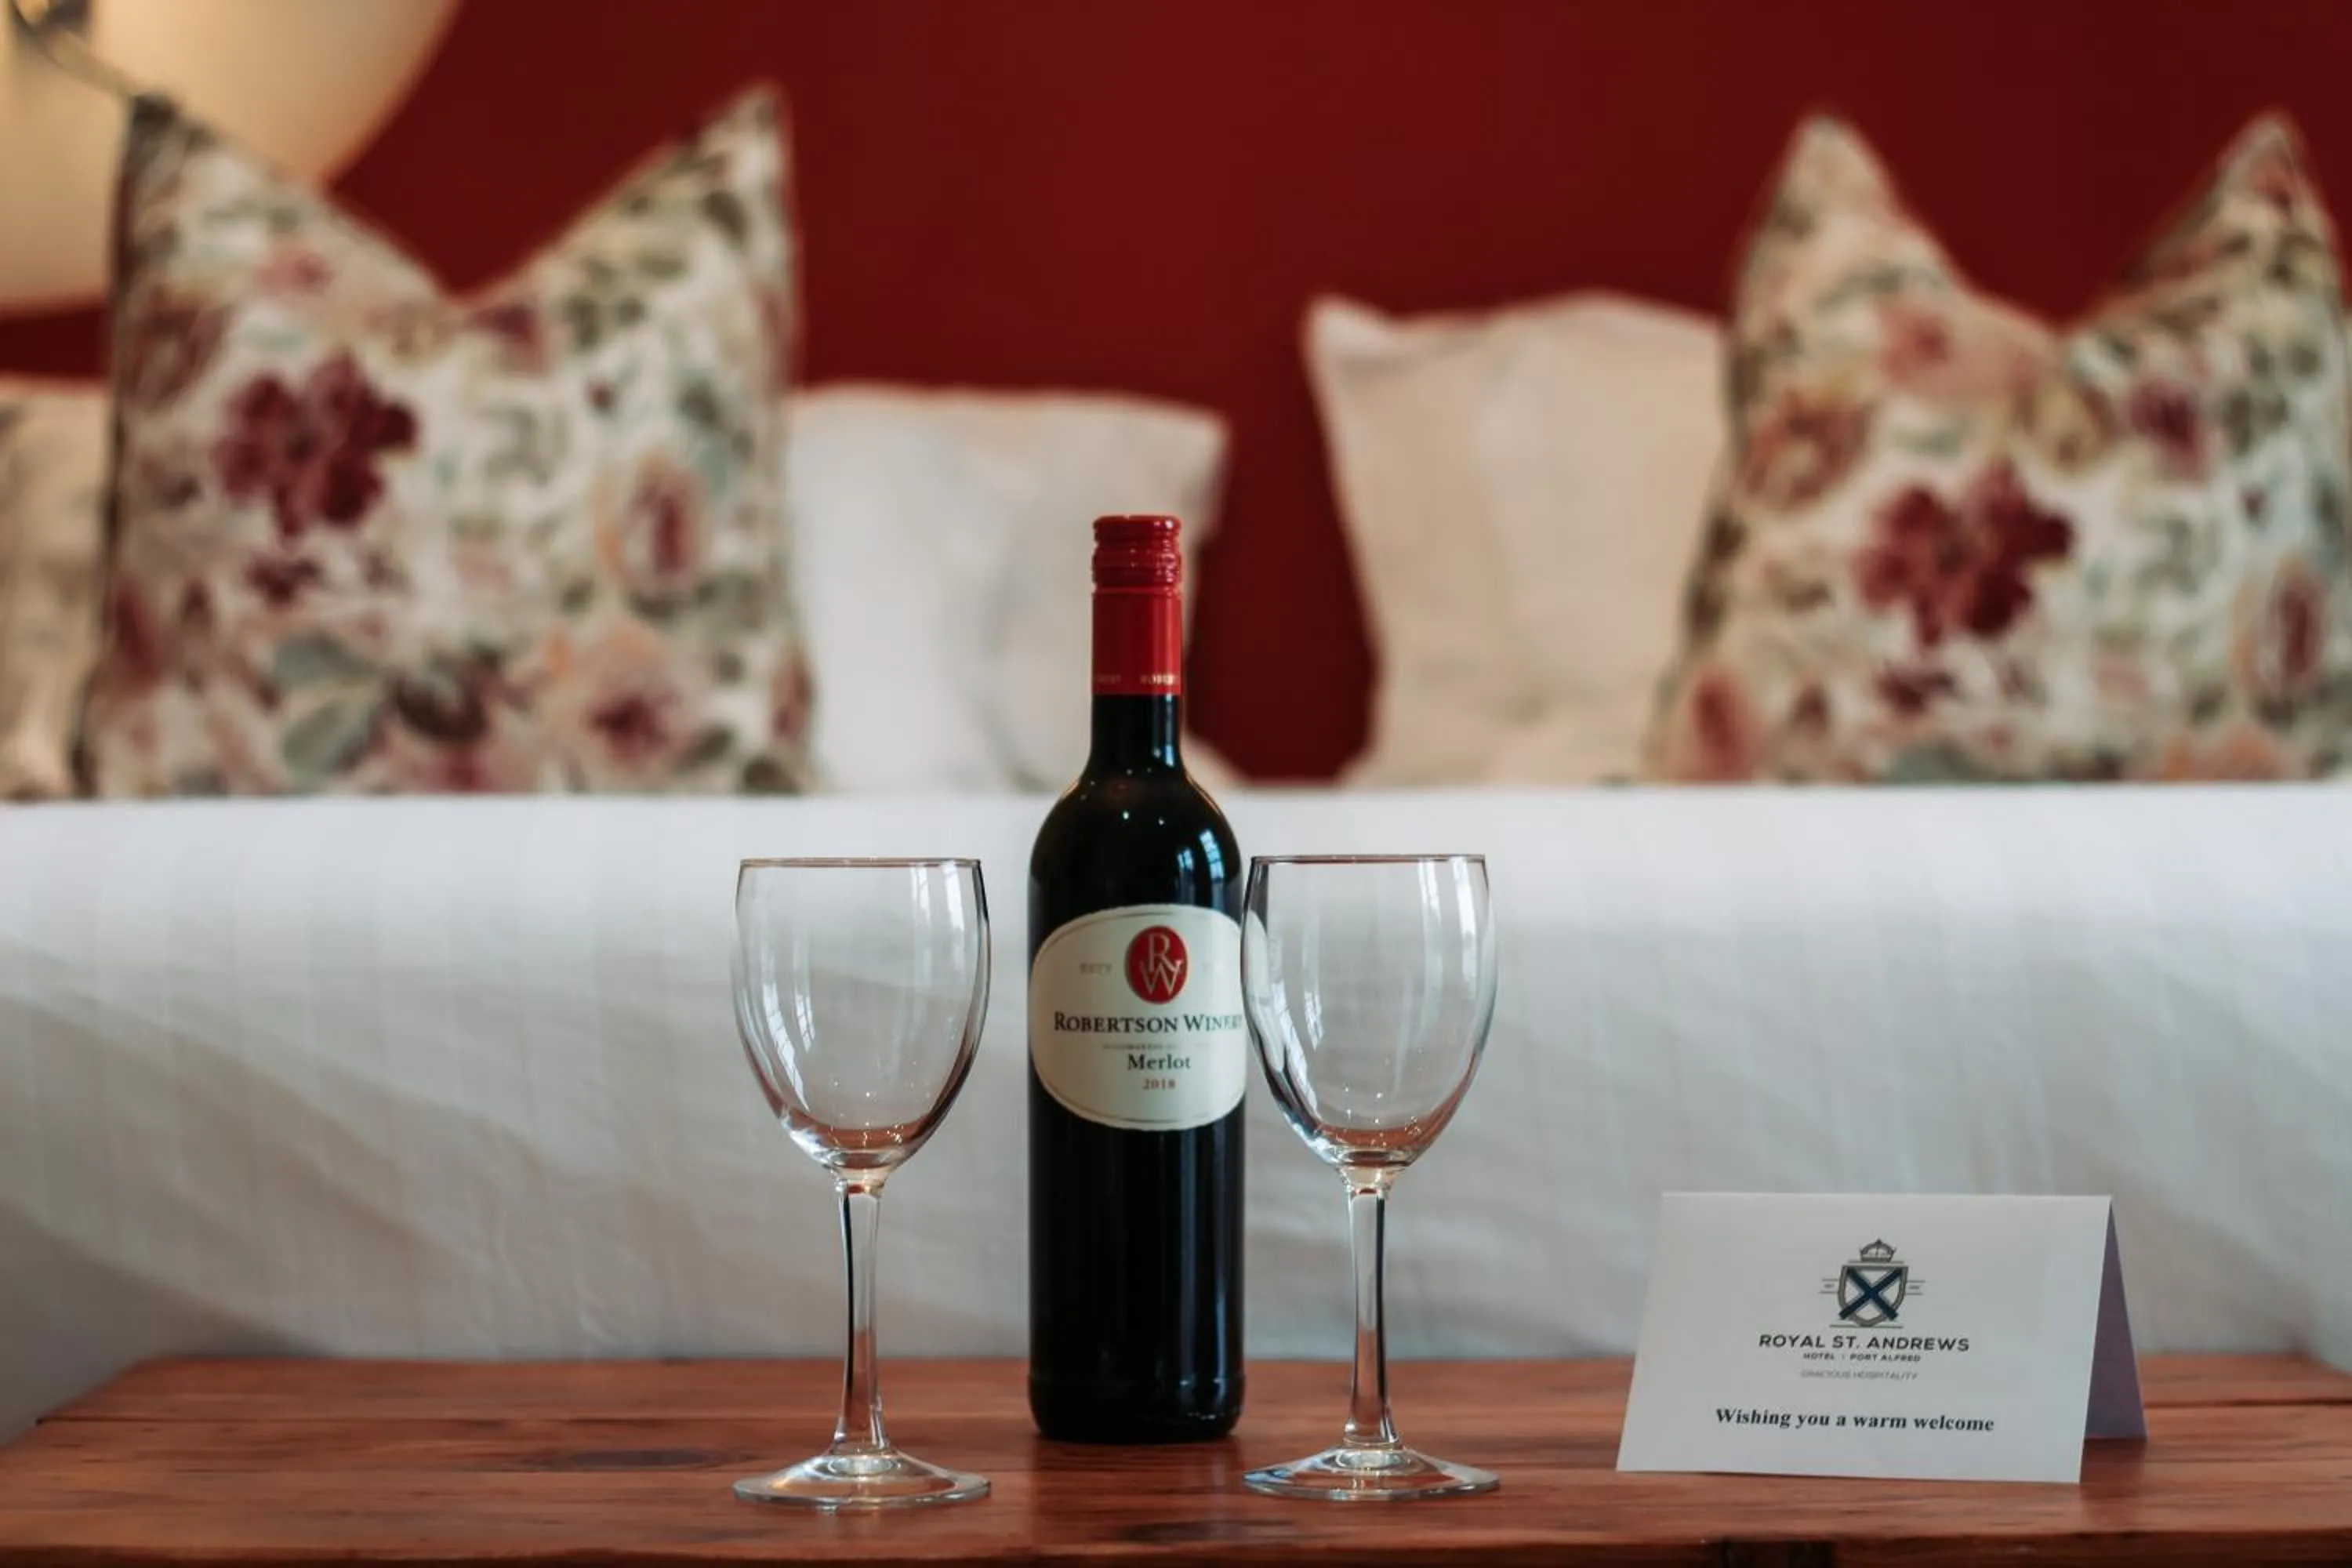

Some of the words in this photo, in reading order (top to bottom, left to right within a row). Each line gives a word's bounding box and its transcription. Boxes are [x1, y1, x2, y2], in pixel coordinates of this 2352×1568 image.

[1054, 1011, 1178, 1033] ROBERTSON
[1127, 1053, 1191, 1071] Merlot
[1759, 1334, 1826, 1348] ROYAL
[1831, 1334, 1861, 1349] ST.
[1867, 1336, 1969, 1352] ANDREWS
[1802, 1352, 1835, 1360] HOTEL
[1850, 1353, 1878, 1362] PORT
[1880, 1354, 1921, 1363] ALFRED
[1715, 1407, 1791, 1429] Wishing
[1795, 1414, 1830, 1429] you
[1835, 1415, 1846, 1427] a
[1853, 1414, 1907, 1429] warm
[1913, 1414, 1994, 1432] welcome
